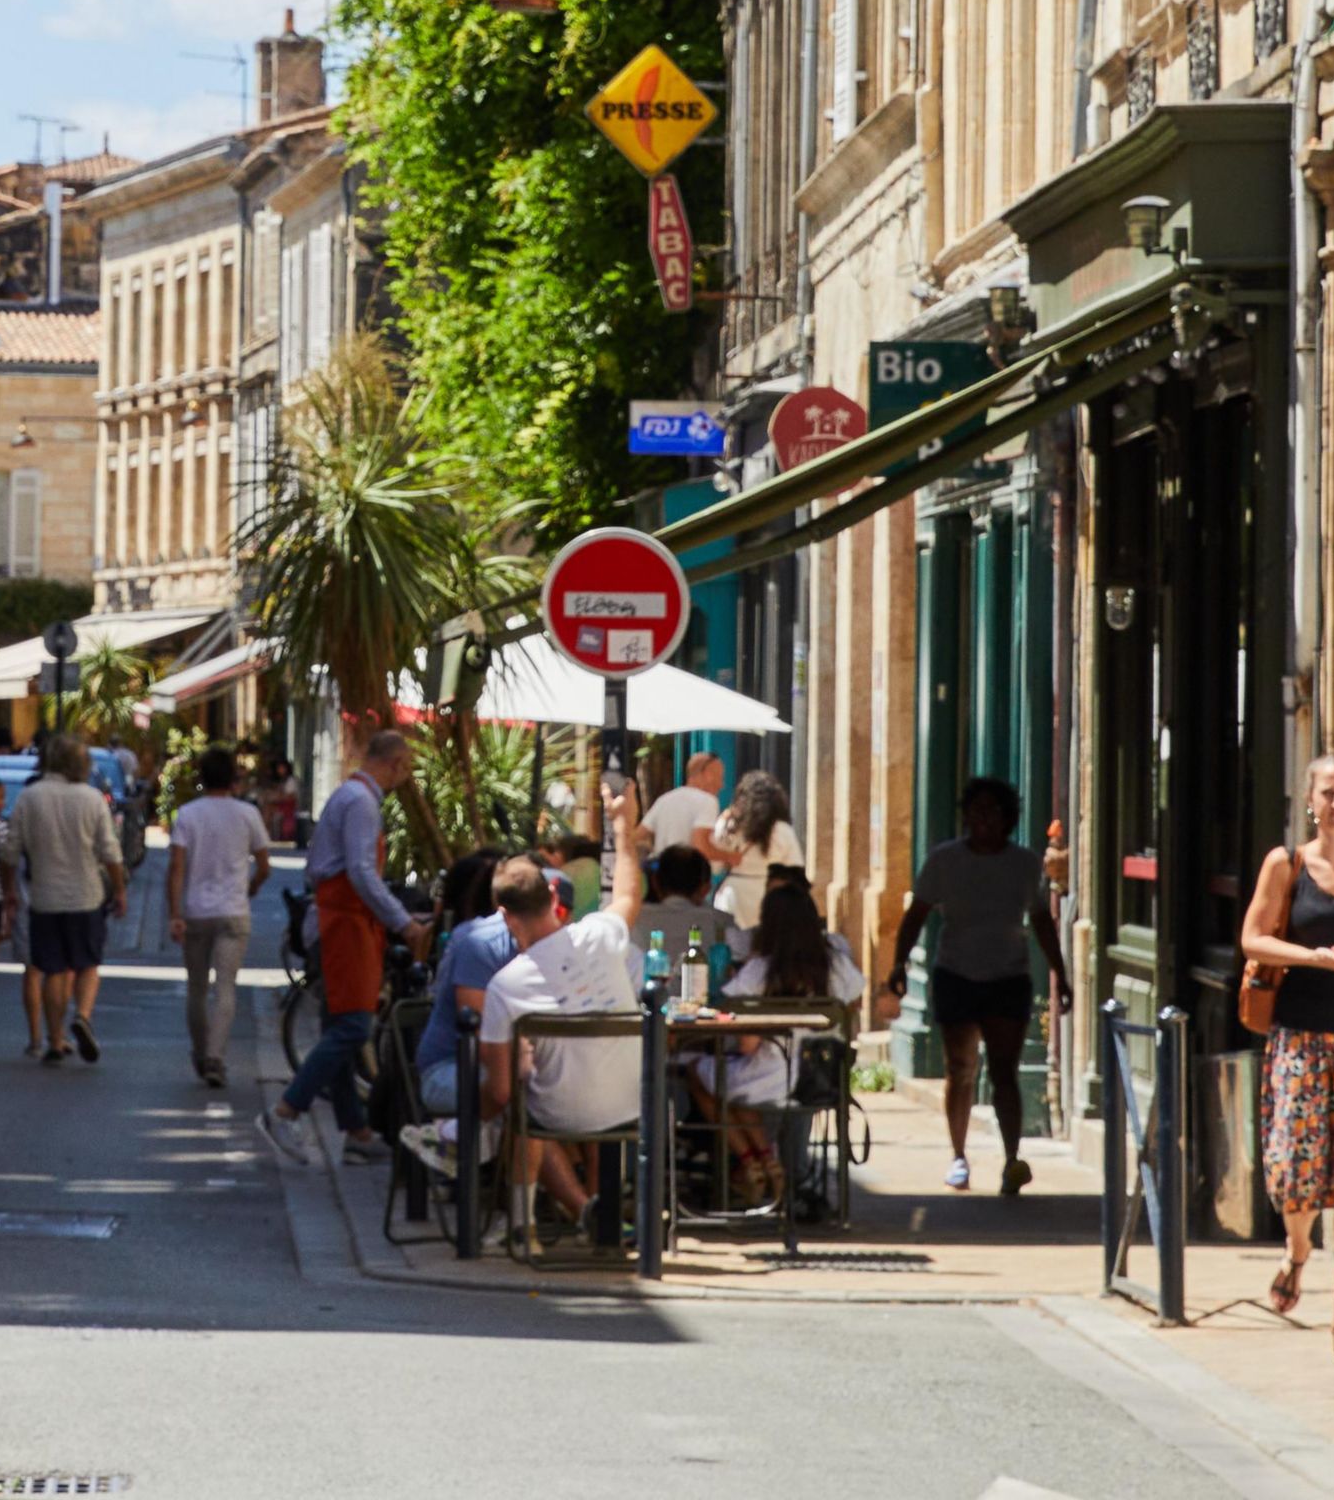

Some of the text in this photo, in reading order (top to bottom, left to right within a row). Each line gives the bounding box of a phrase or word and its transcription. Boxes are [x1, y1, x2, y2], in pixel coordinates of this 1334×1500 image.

[601, 102, 704, 120] PRESSE
[656, 180, 687, 304] TABAC
[876, 350, 943, 384] Bio
[643, 418, 682, 437] FDJ
